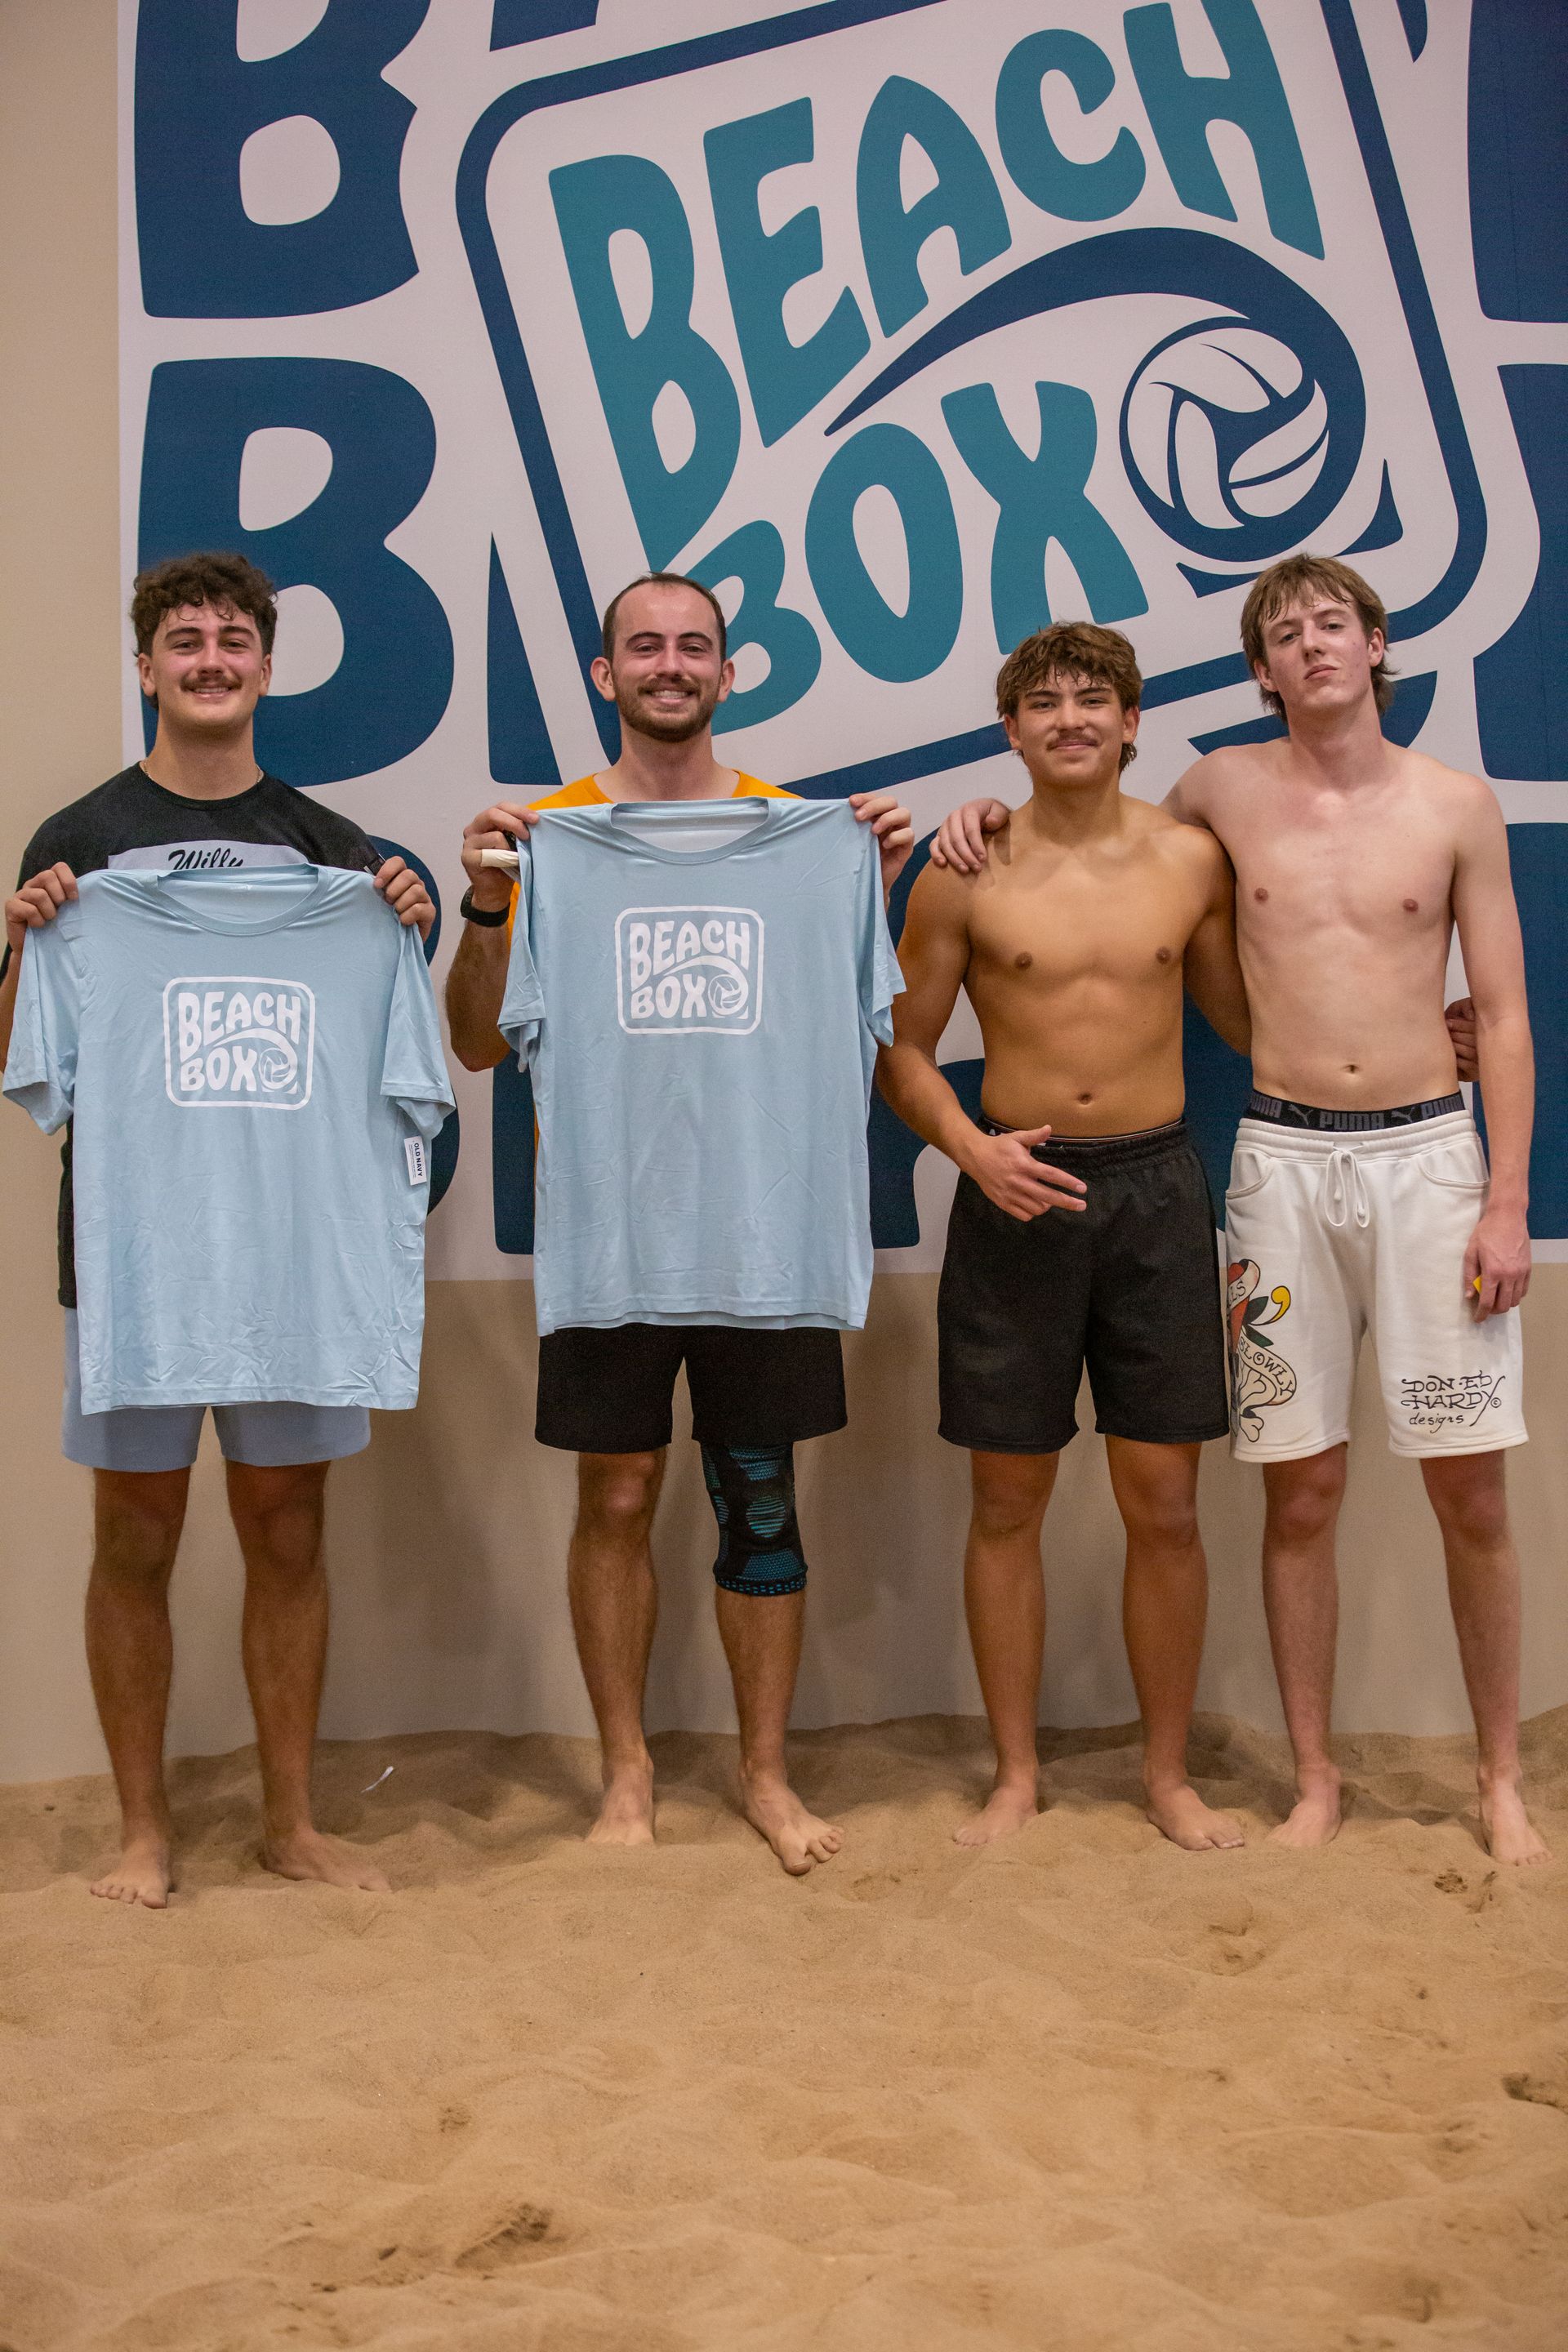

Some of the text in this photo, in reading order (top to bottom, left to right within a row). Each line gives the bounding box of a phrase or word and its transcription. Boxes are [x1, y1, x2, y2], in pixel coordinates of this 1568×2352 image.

[549, 0, 1325, 573] BEACH
[684, 381, 1149, 737] BOX
[630, 920, 750, 991] BEACH
[630, 973, 707, 1019] BOX
[178, 991, 301, 1062] BEACH
[180, 1046, 257, 1091] BOX
[1250, 1093, 1282, 1118] UMA
[1319, 1111, 1385, 1131] PUMA
[1238, 1335, 1294, 1396] SLOWLY
[1401, 1375, 1455, 1393] DON
[1401, 1376, 1505, 1427] HARDY
[1409, 1412, 1464, 1433] designs
